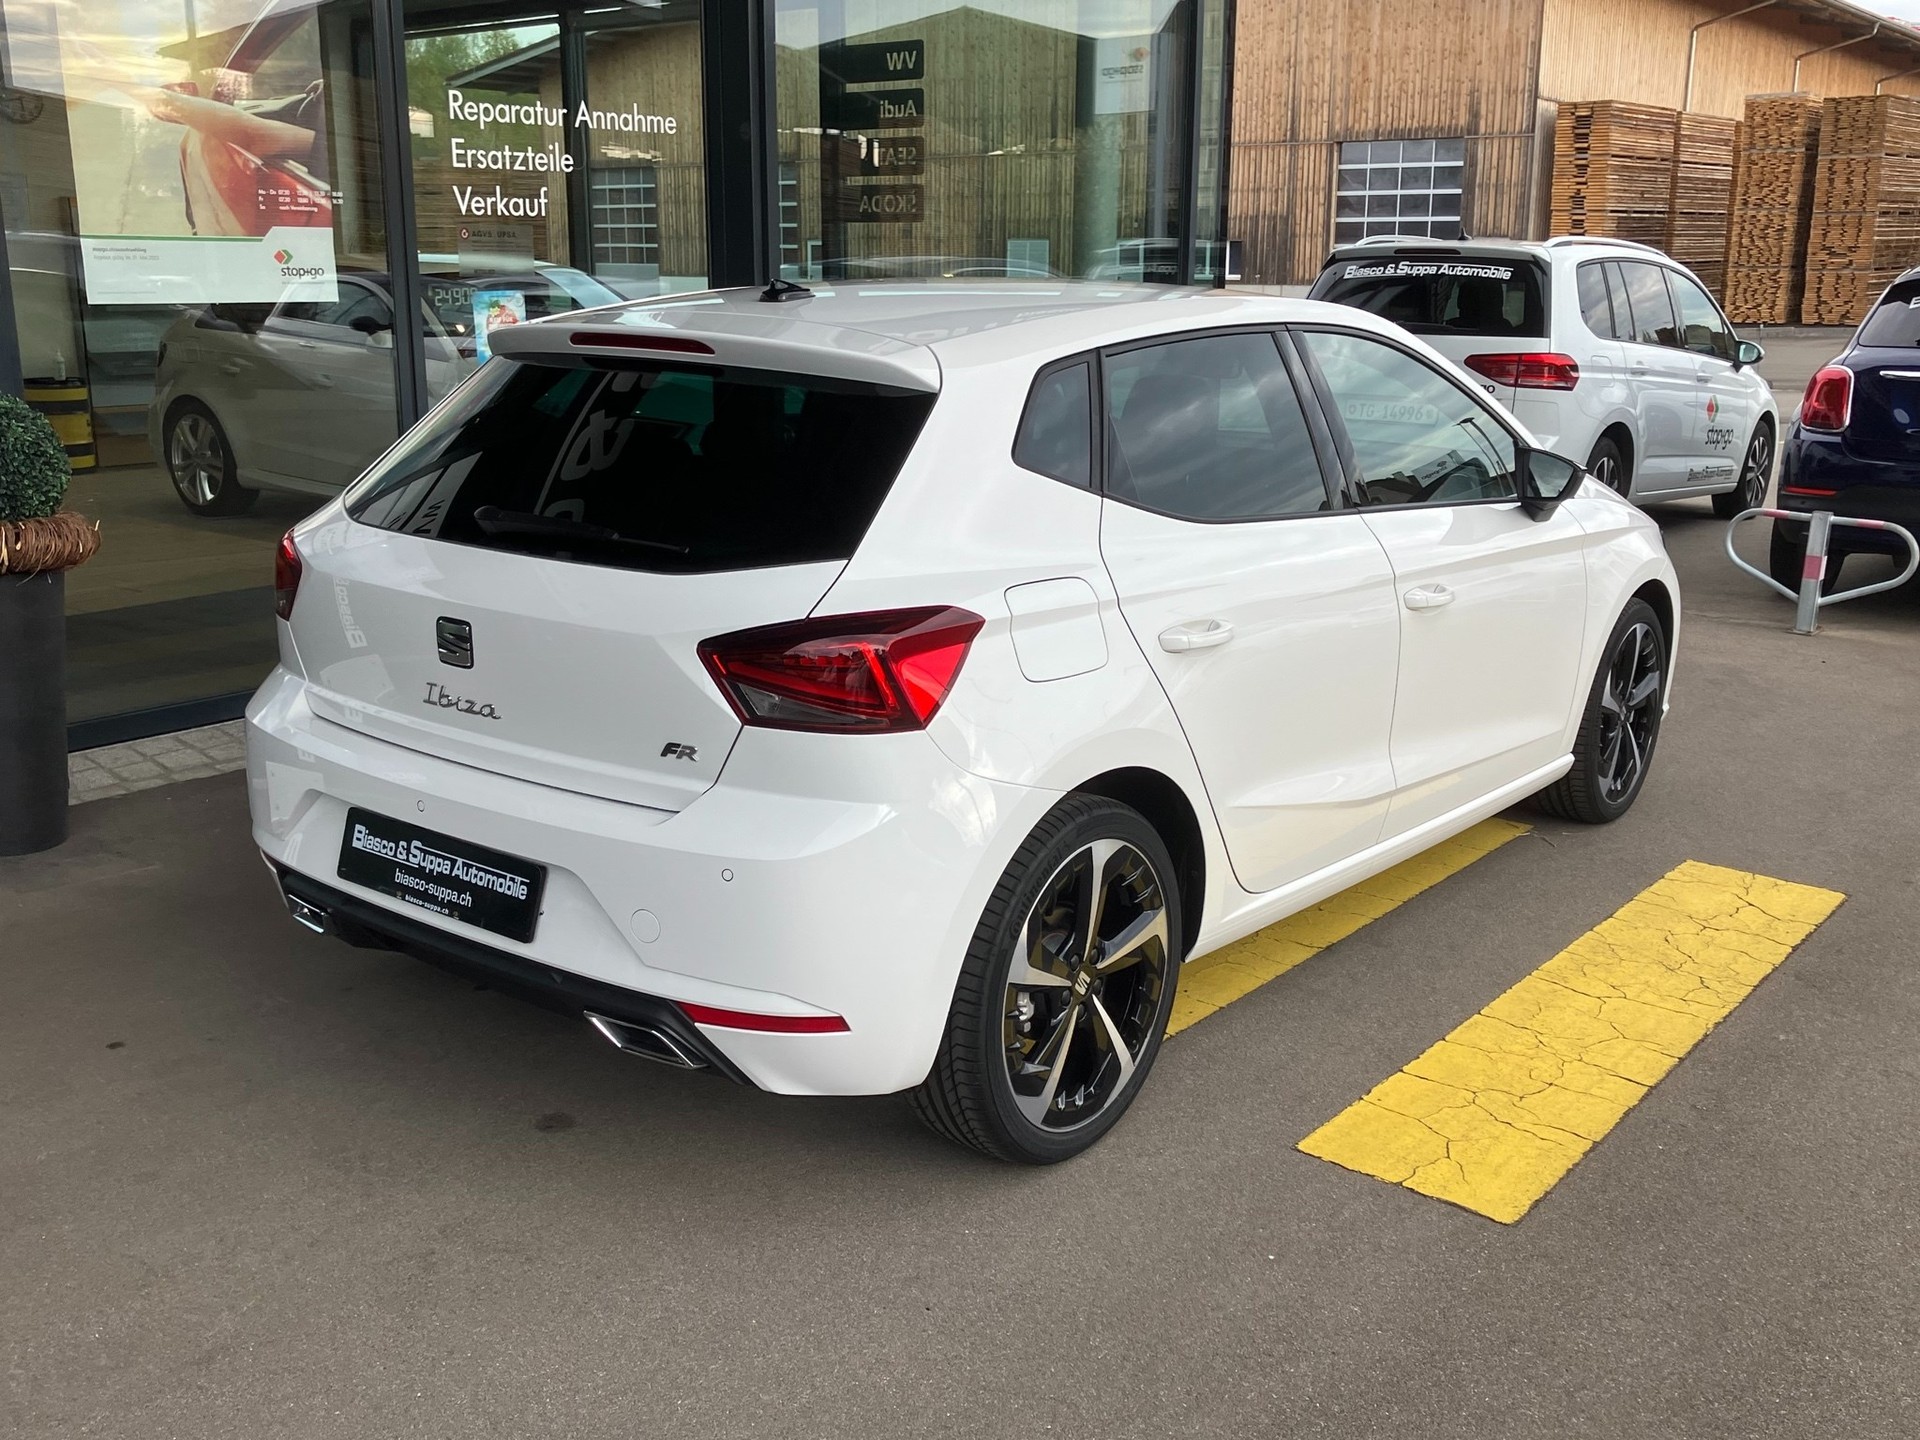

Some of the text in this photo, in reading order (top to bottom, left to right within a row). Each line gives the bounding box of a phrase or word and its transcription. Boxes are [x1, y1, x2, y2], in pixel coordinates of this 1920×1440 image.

[448, 89, 678, 135] Reparatur Annahme
[450, 137, 575, 173] Ersatzteile
[451, 185, 549, 217] Verkauf
[281, 265, 325, 280] stop+go
[1343, 261, 1514, 280] Biasco & Suppa Automobile
[1360, 403, 1424, 421] TG 14996
[423, 681, 503, 720] Ibiza
[660, 741, 700, 763] FR
[352, 823, 531, 901] Biasco & Suppa Automobile
[394, 867, 473, 908] biasco-suppa.ch
[404, 893, 450, 916] biasco-suppa.ch
